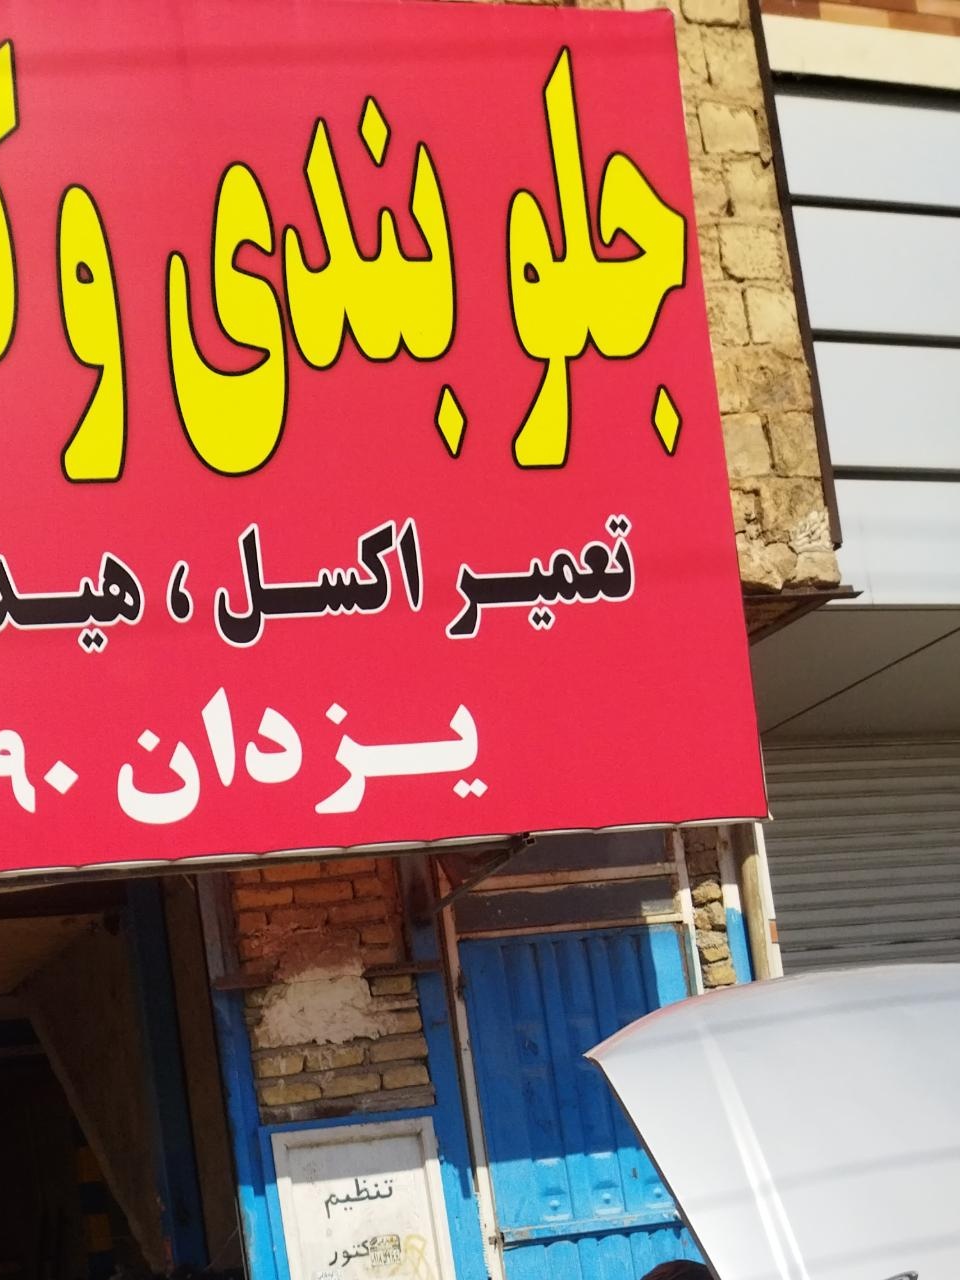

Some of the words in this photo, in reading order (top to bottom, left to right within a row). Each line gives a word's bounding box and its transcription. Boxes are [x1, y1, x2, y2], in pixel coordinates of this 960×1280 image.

[167, 97, 467, 478] بندی
[506, 46, 688, 468] جلو
[56, 184, 127, 483] و
[215, 519, 424, 647] اکسل
[446, 515, 635, 638] تعمیر
[116, 686, 489, 825] یزدان
[324, 1178, 393, 1218] تنظیم
